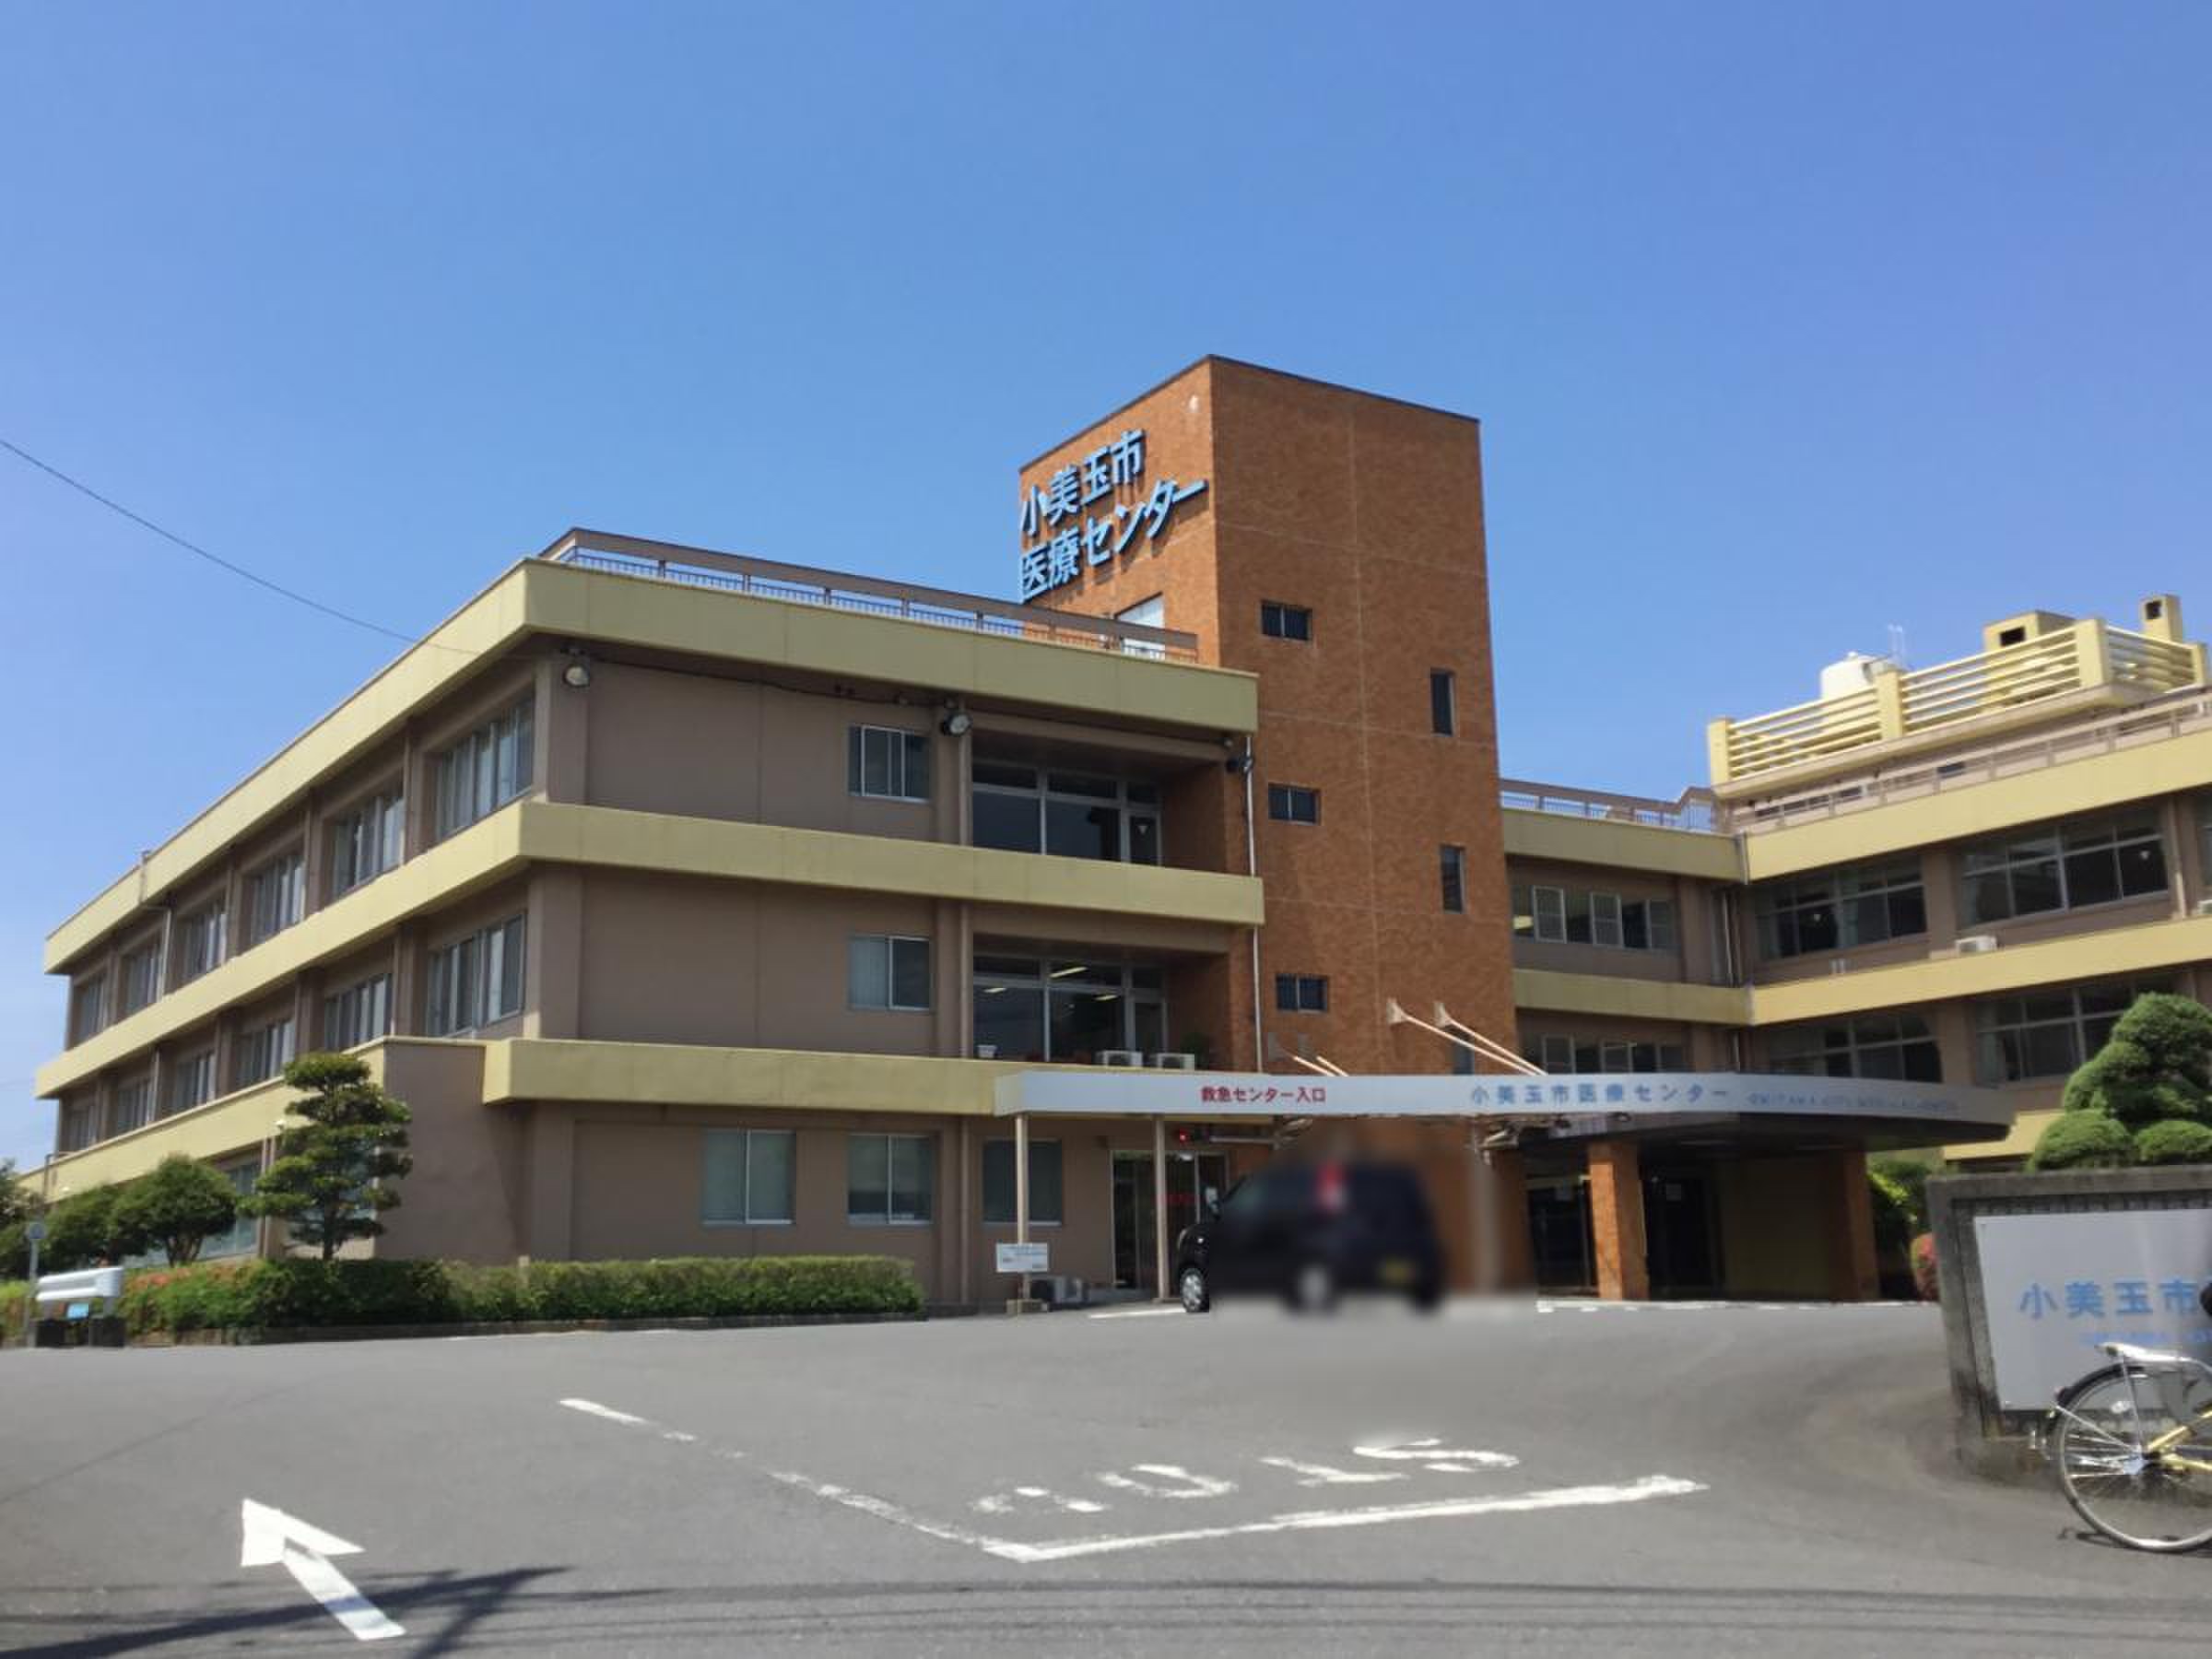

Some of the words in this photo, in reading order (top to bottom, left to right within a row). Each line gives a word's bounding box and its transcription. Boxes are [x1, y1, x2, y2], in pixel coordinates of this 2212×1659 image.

[1020, 429, 1146, 537] 小美玉市
[1020, 478, 1208, 604] 医療センター
[1201, 1086, 1326, 1103] 救急センター入口
[1471, 1083, 1727, 1104] 小美玉市医療センター
